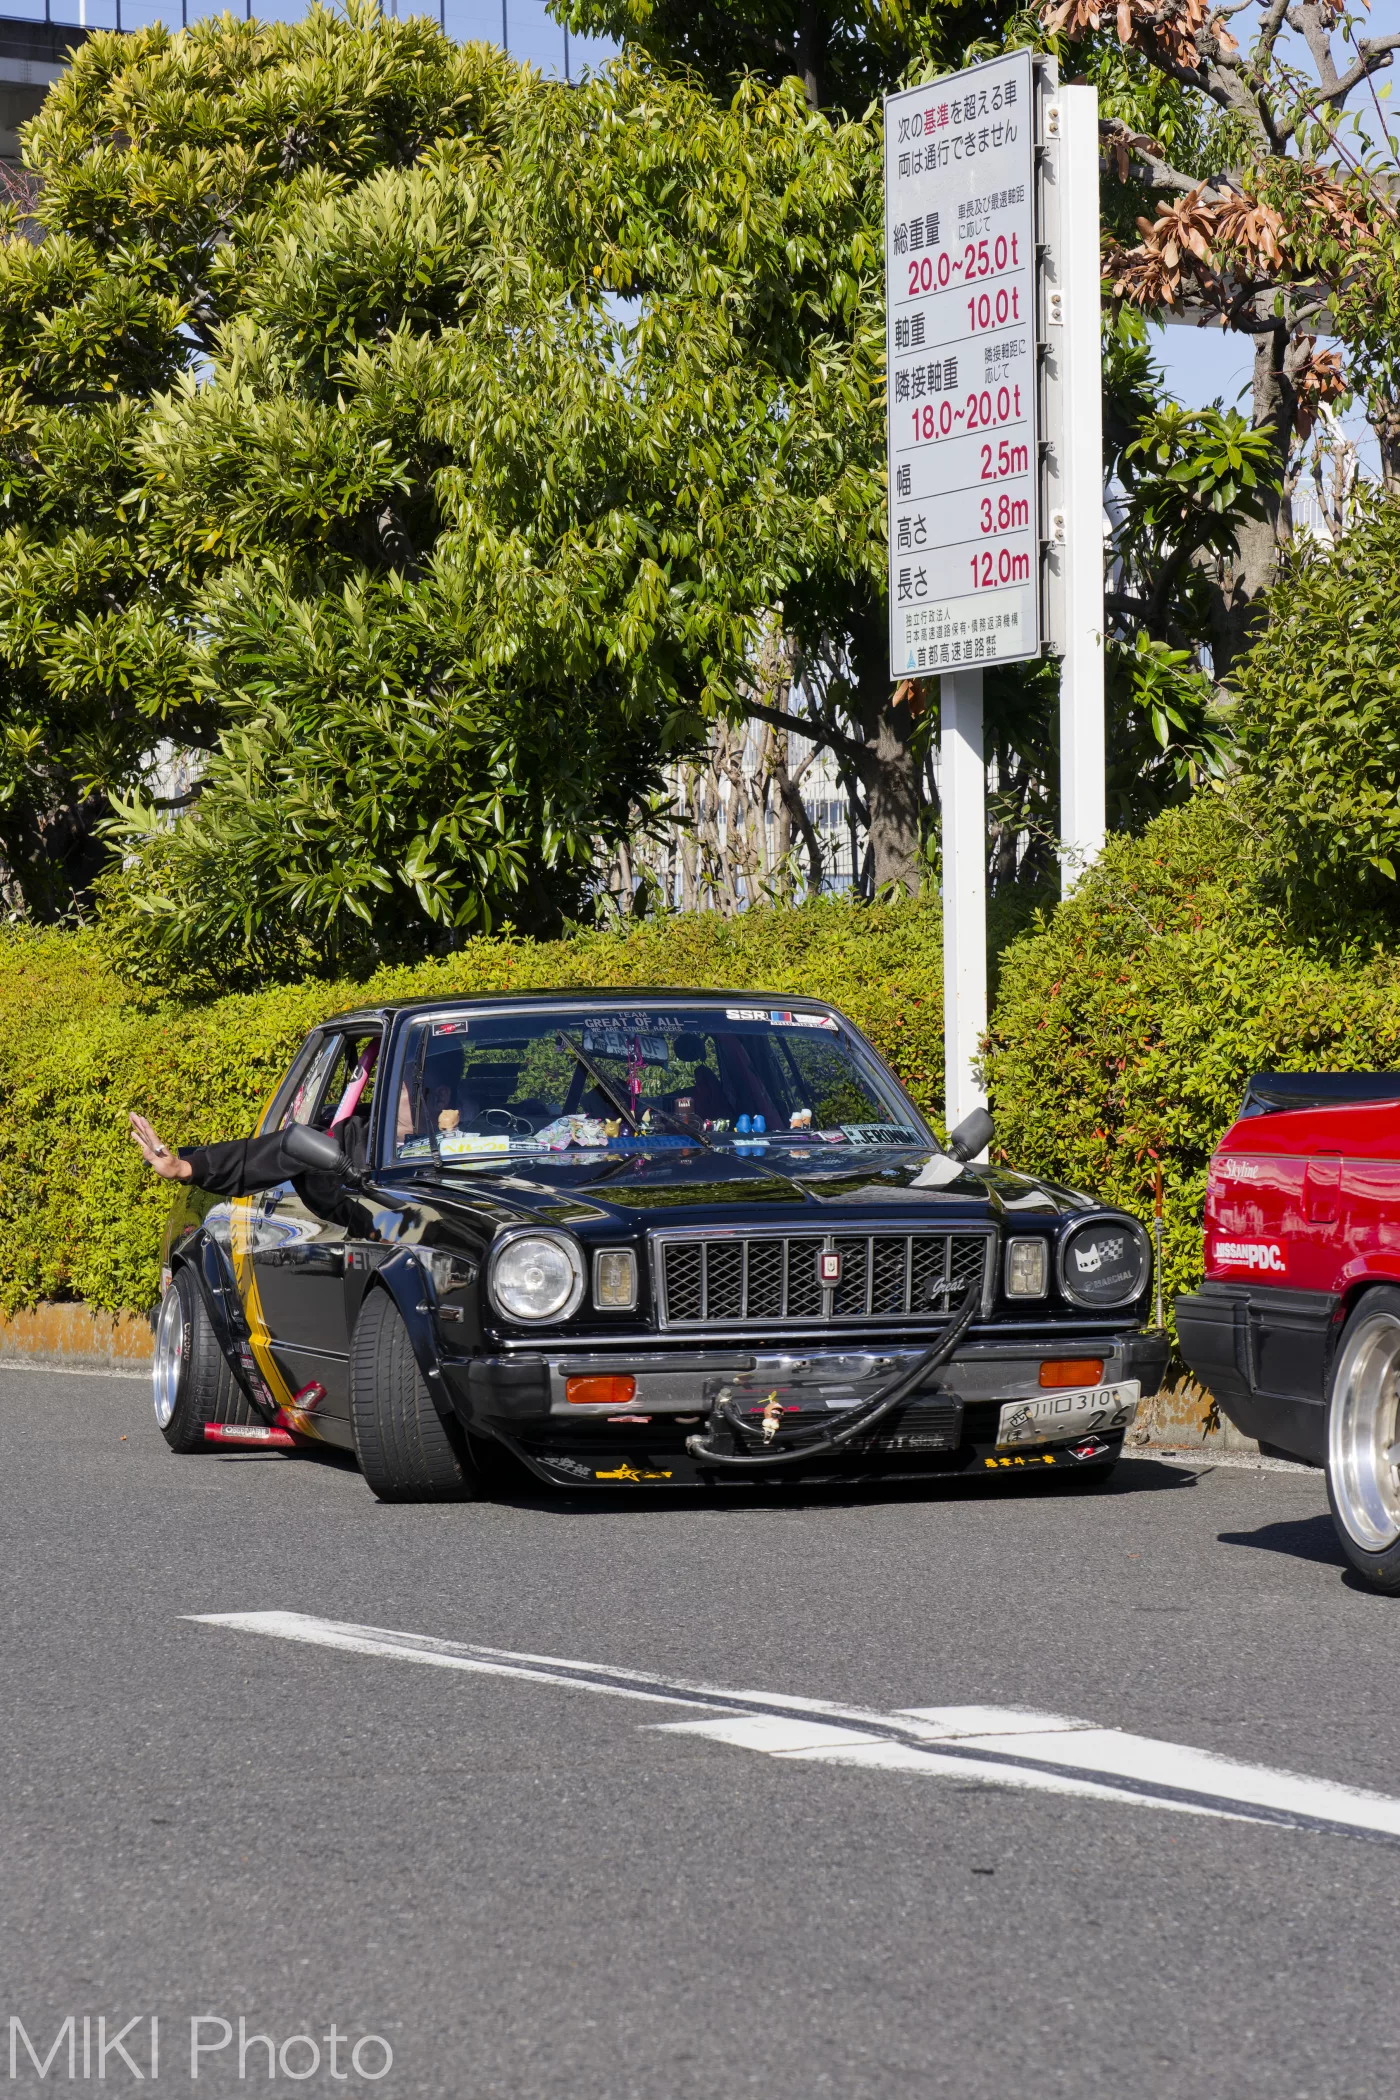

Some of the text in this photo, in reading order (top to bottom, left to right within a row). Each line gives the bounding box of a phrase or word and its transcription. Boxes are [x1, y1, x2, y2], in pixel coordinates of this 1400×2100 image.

[897, 79, 1018, 144] 次の基準を超える車
[898, 119, 1018, 180] 両は通行できません
[893, 212, 940, 256] 総重量
[958, 216, 991, 240] に応じて
[894, 311, 926, 351] 軸重
[984, 339, 1026, 364] 隣接軸距に
[895, 356, 959, 403] 隣接軸重
[984, 363, 1010, 384] 応じて
[980, 440, 1028, 480] 2.5m
[896, 463, 912, 498] 幅
[980, 494, 1029, 533] 3.8m
[897, 513, 928, 551] 高さ
[897, 565, 928, 602] 長さ
[970, 548, 1030, 589] 12.0m
[905, 607, 951, 628] 独立行政法人
[917, 637, 985, 667] 首都高速道路
[584, 1017, 684, 1028] GREAT OF ALL
[726, 1009, 768, 1021] SSR
[1224, 1158, 1259, 1185] Skyline
[1216, 1242, 1249, 1259] NISSAN
[931, 1276, 965, 1300] Great
[1093, 1270, 1134, 1289] MARCHAL
[1006, 1428, 1023, 1443] ほ
